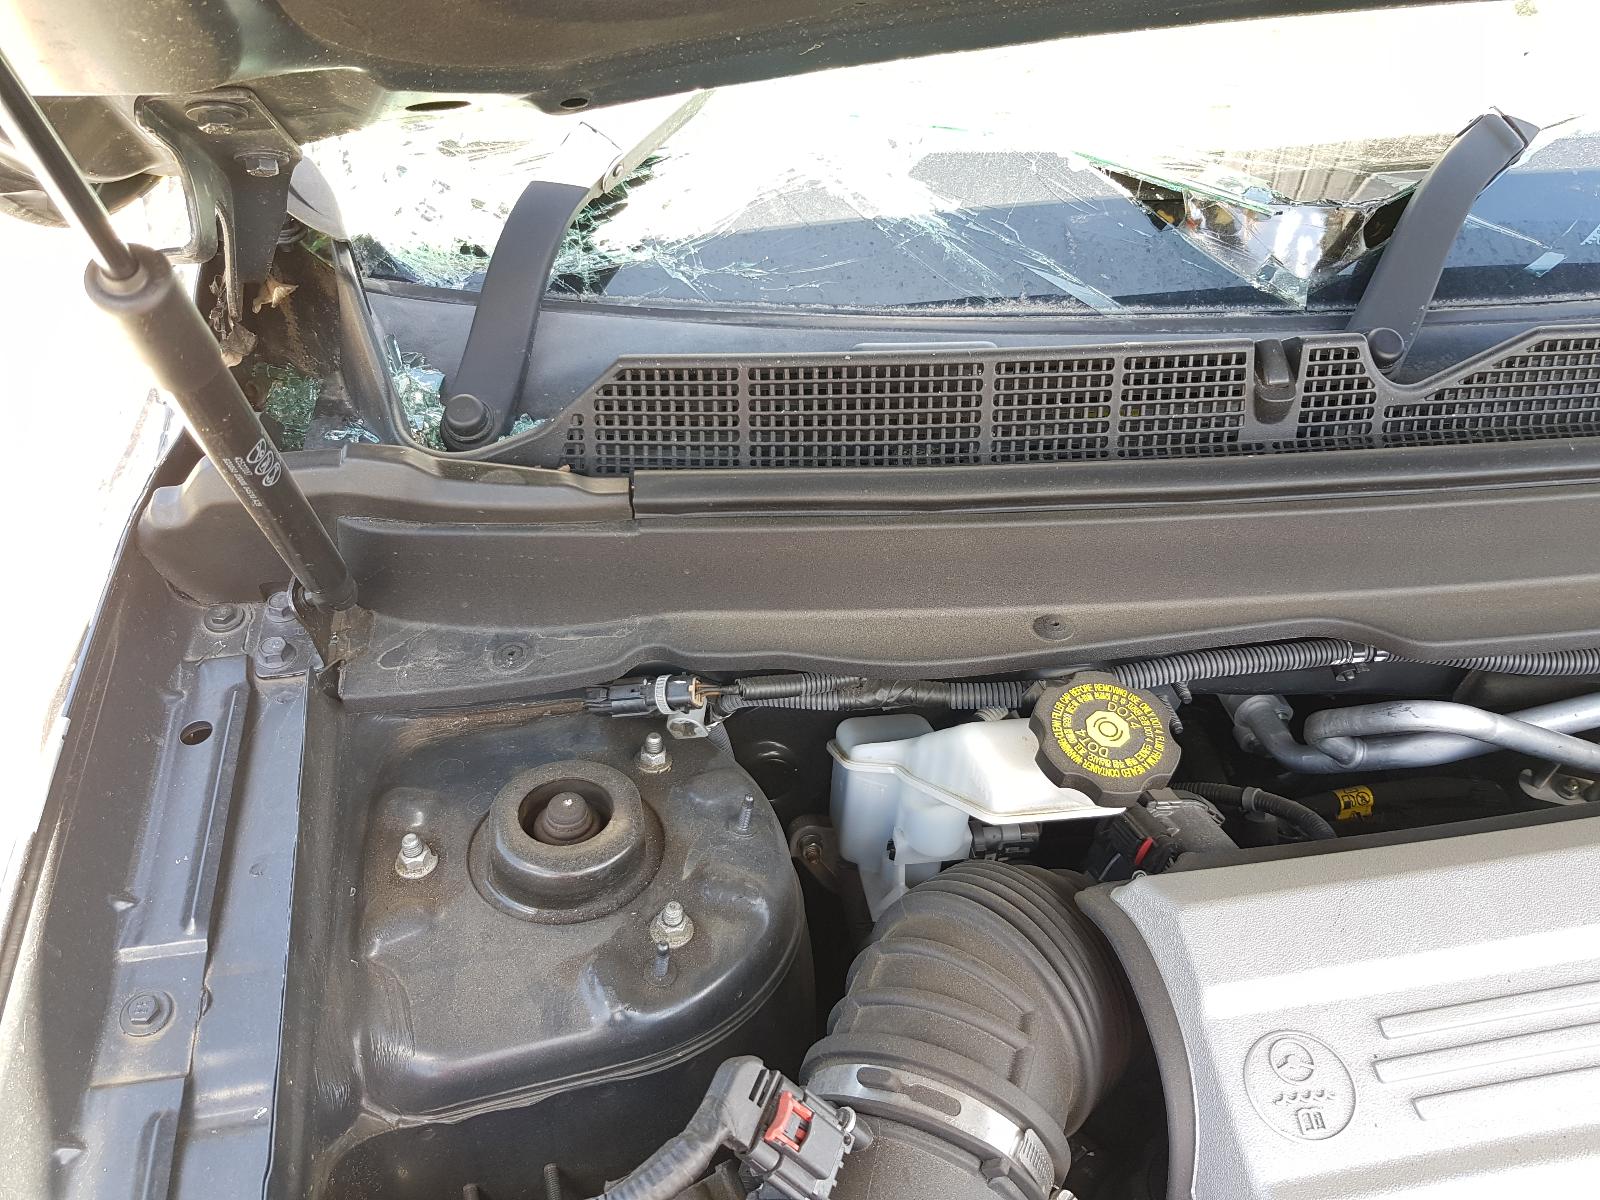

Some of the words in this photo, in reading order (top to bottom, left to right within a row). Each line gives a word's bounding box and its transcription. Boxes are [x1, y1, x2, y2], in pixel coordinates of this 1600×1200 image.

[1108, 702, 1136, 721] DOT
[1130, 722, 1141, 730] 4
[1075, 729, 1087, 737] 4
[1128, 693, 1142, 705] USE
[1141, 761, 1151, 770] A
[1078, 735, 1108, 757] DOT
